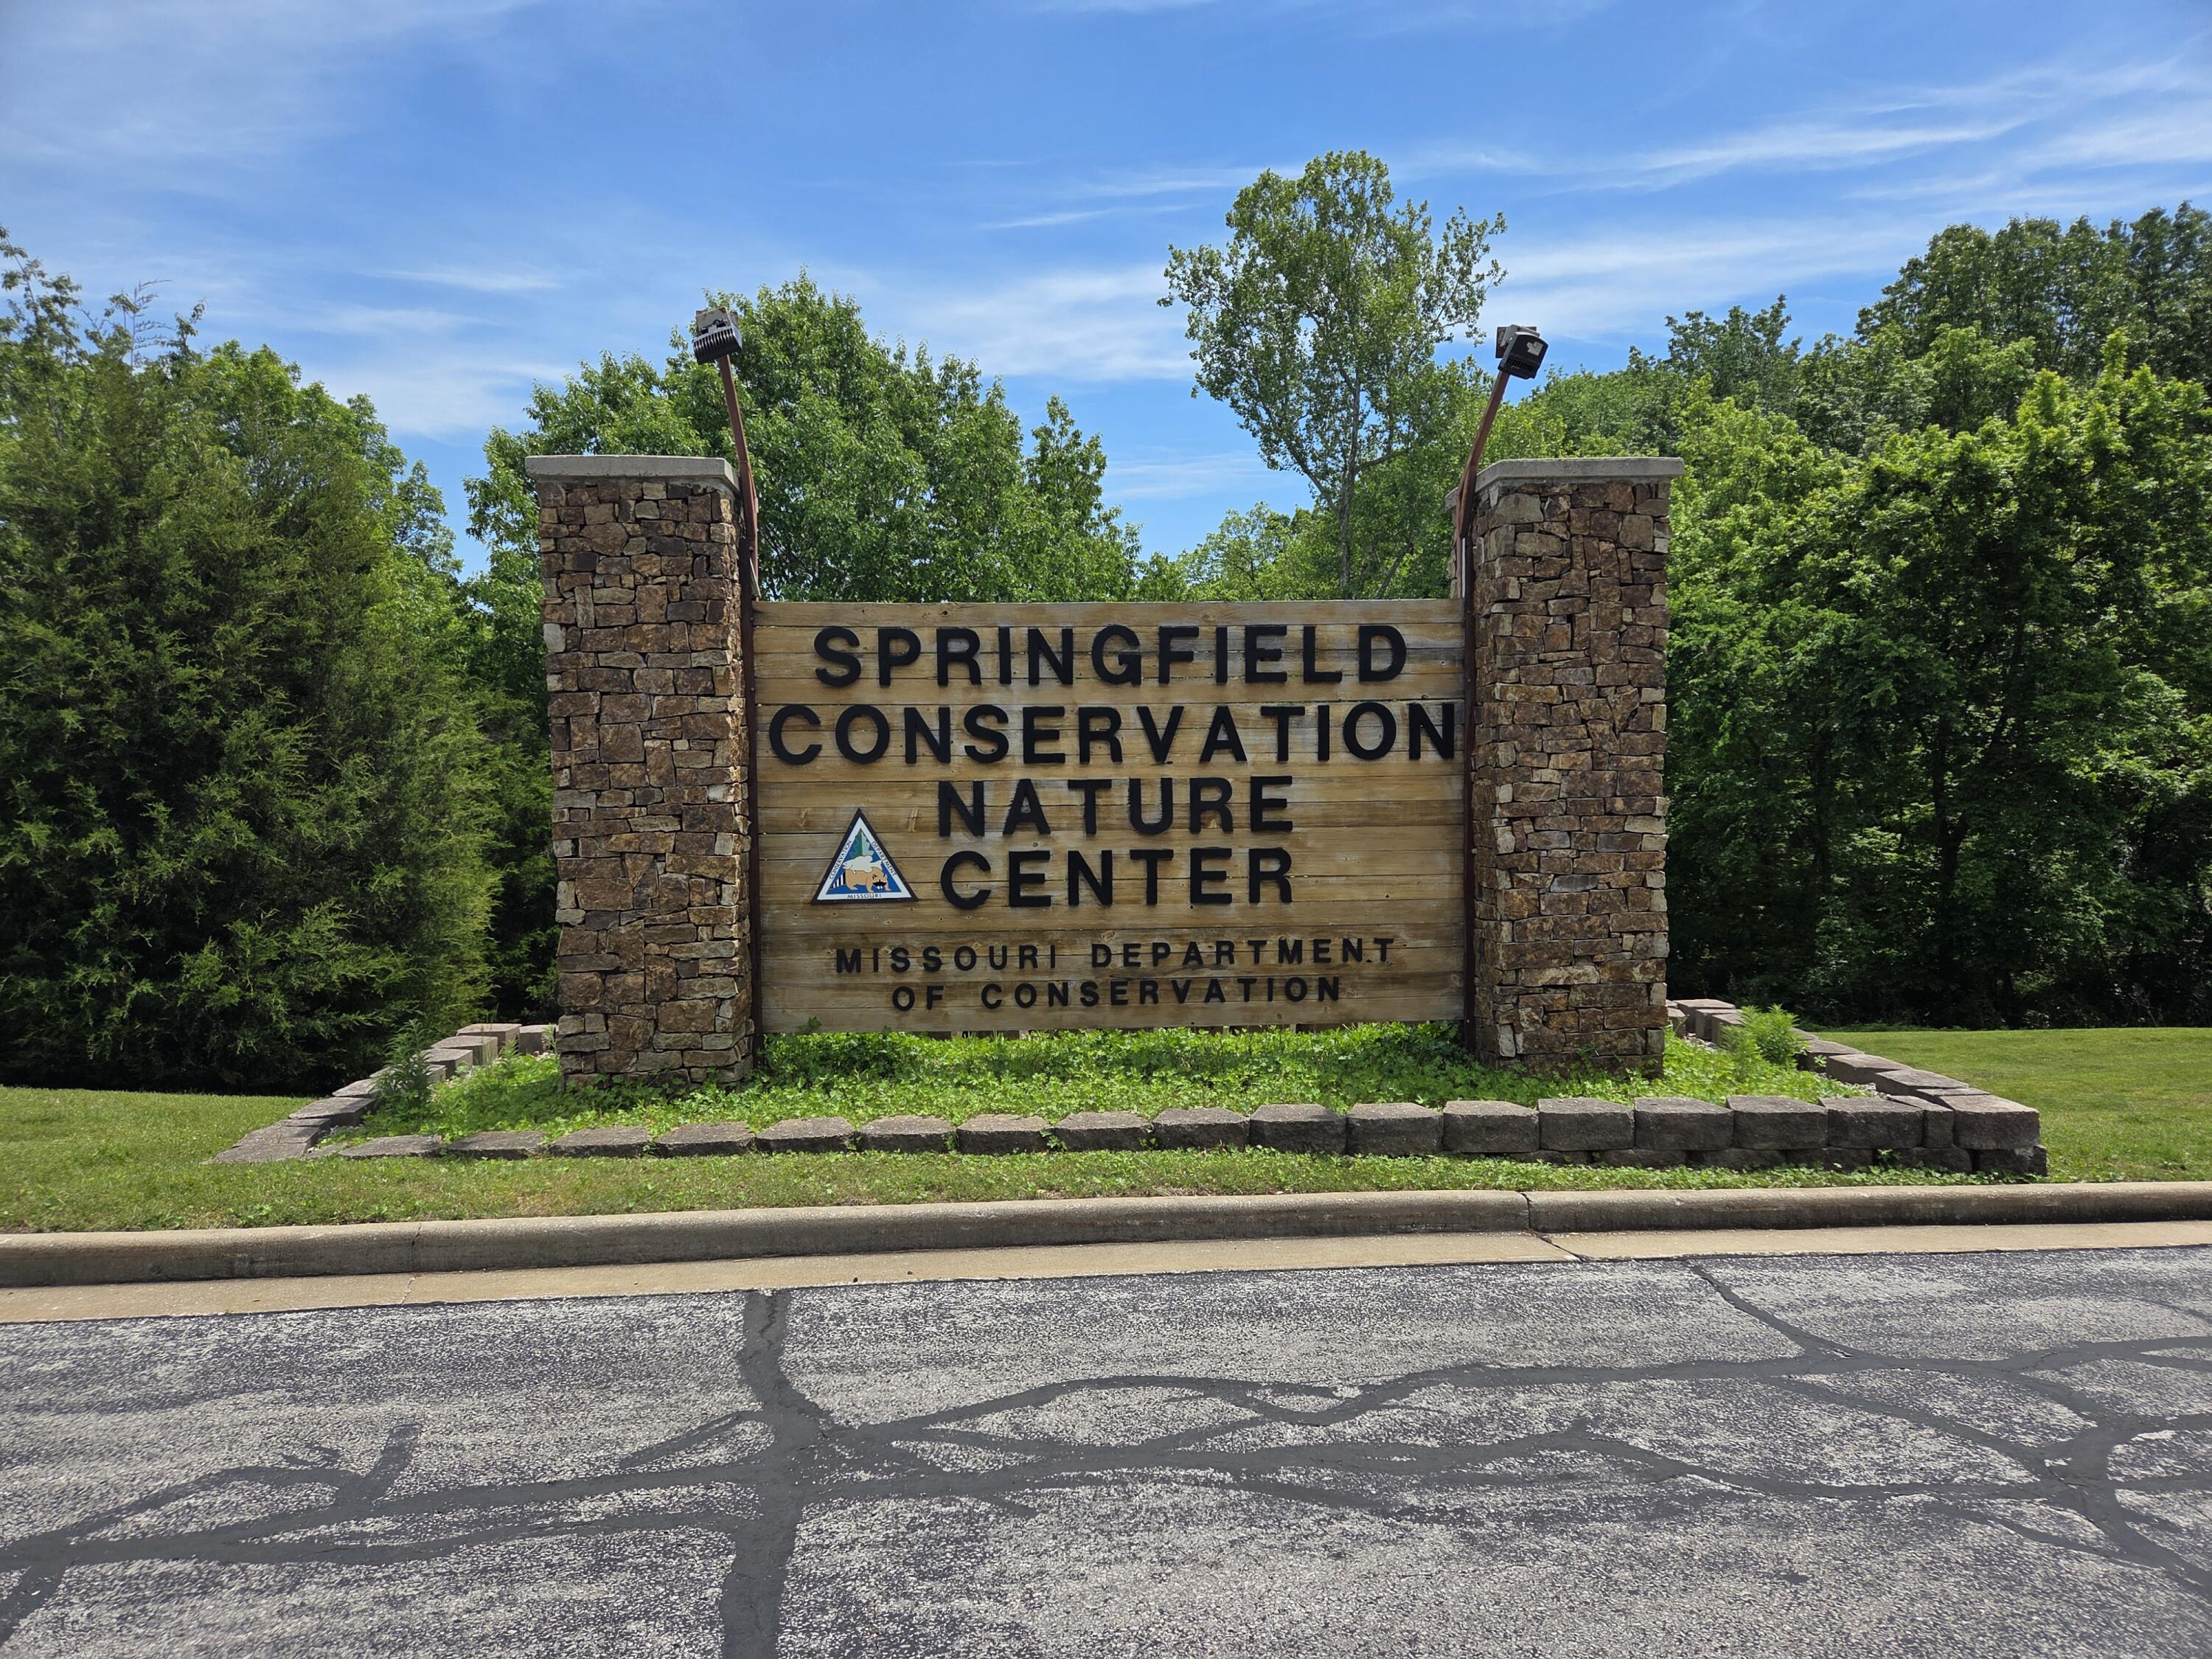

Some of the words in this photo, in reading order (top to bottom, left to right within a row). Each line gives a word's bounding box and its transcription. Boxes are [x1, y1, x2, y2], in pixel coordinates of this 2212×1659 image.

[814, 625, 1407, 686] SPRINGFIELD
[769, 701, 1455, 765] CONSERVATION
[939, 776, 1293, 837] NATURE
[829, 840, 852, 879] CONSERVATION
[872, 841, 897, 876] DEPARTMENT
[940, 848, 1293, 909] CENTER
[835, 944, 1056, 973] MISSOURI
[1092, 938, 1395, 967] DEPARTMENT
[891, 985, 945, 1011] OF
[981, 976, 1341, 1009] CONSERVATION
